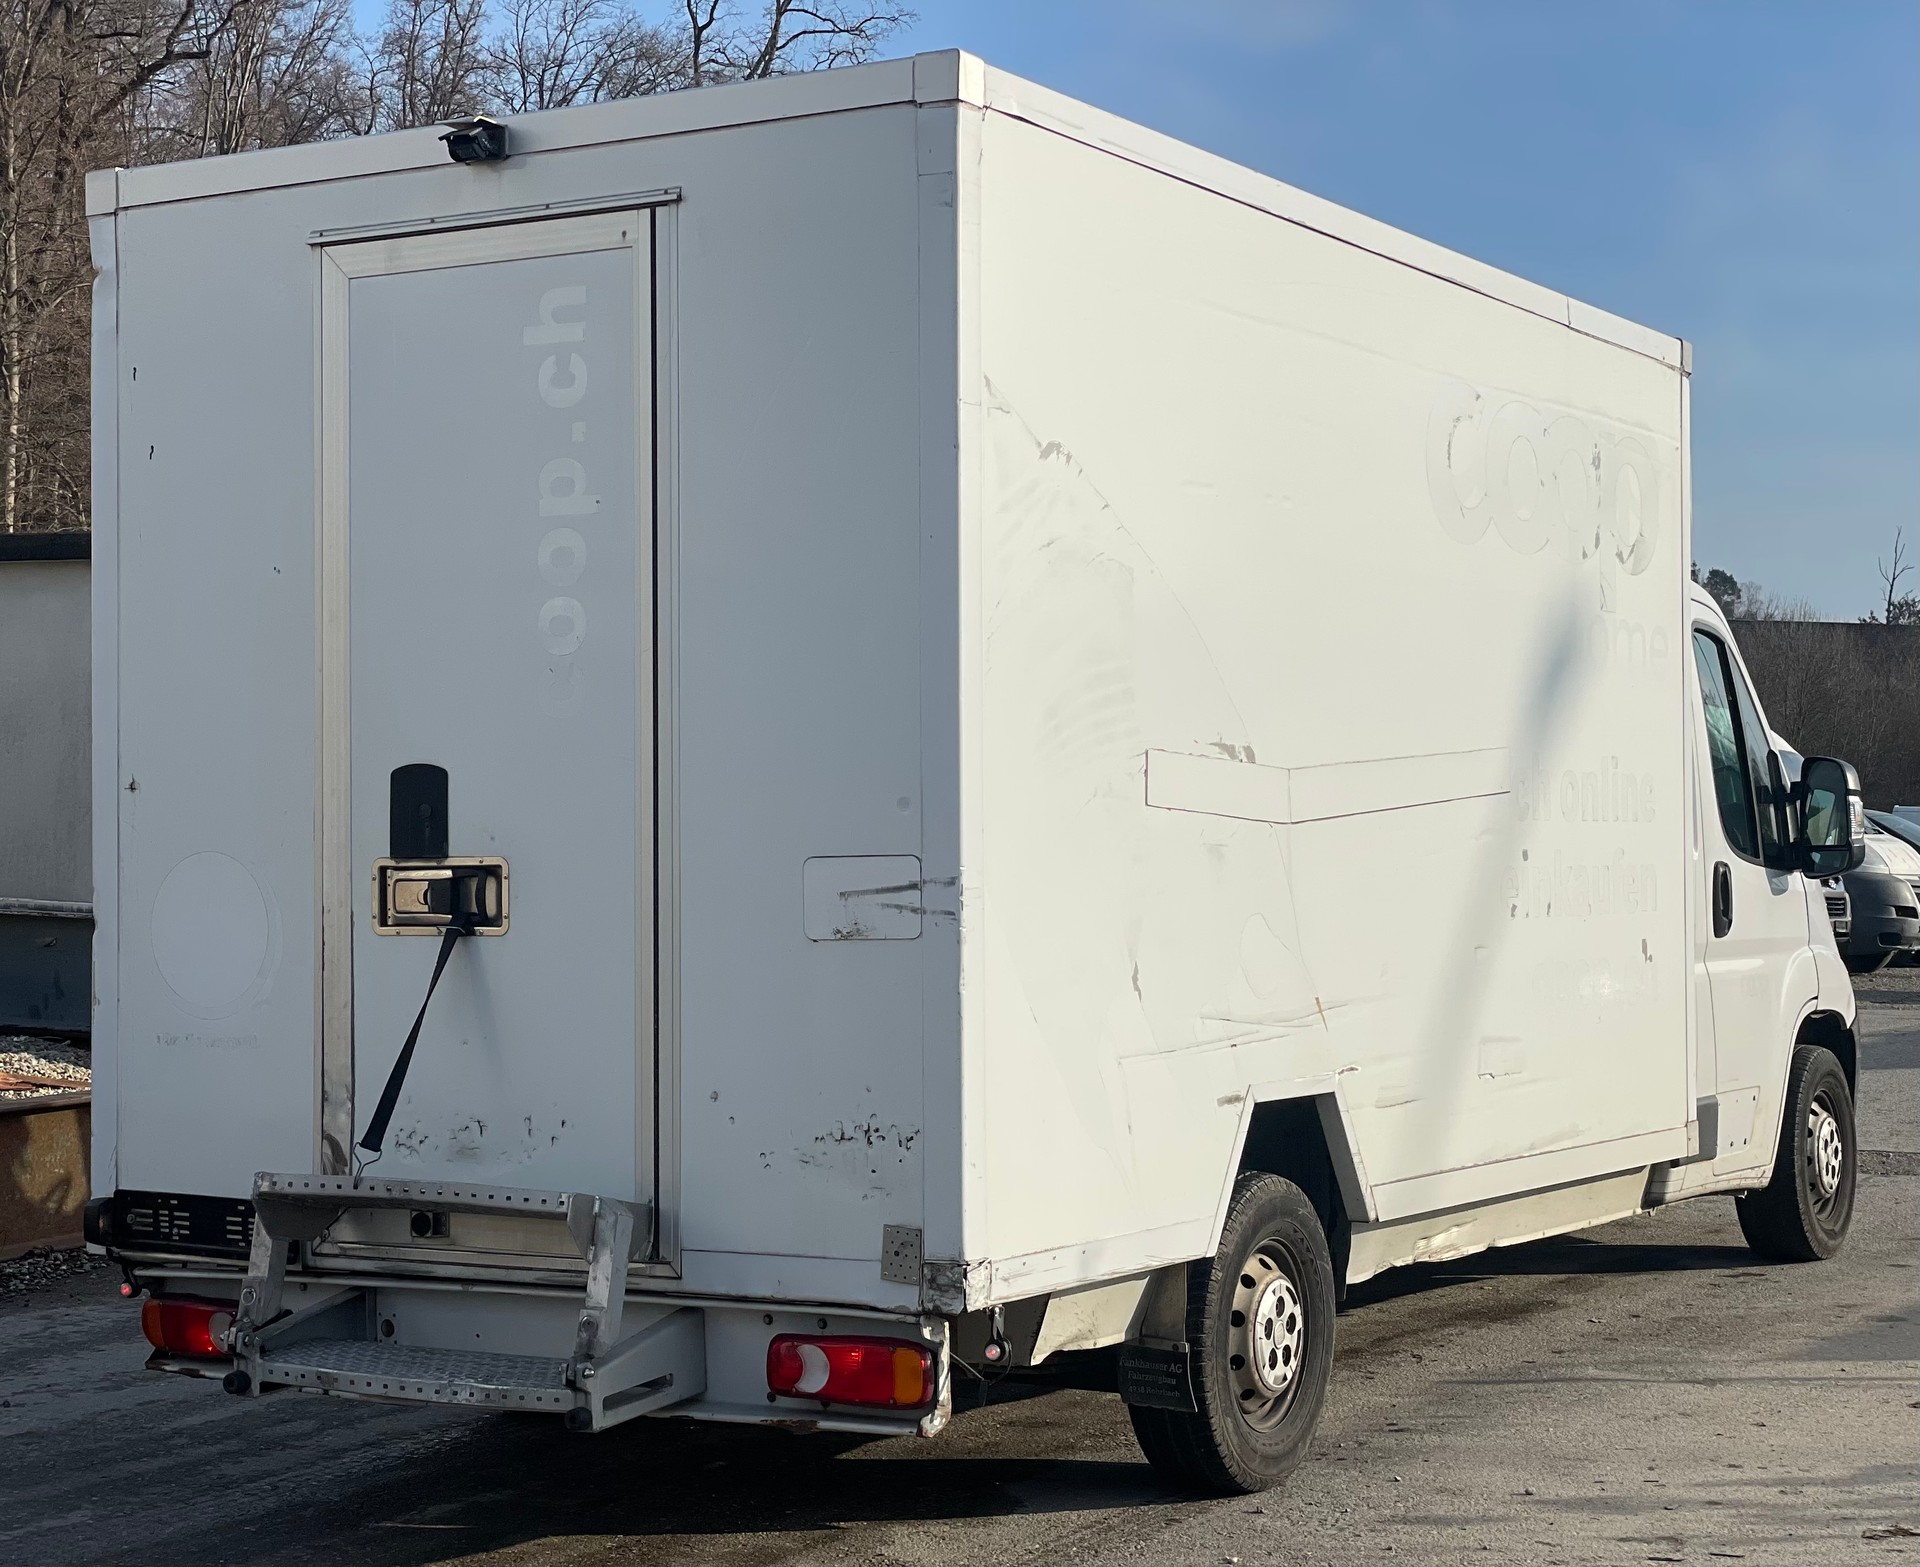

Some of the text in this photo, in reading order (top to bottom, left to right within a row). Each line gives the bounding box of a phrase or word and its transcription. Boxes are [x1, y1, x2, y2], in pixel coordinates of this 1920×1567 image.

[522, 284, 601, 719] coop.ch
[1559, 754, 1657, 823] online
[1168, 1362, 1183, 1374] AG
